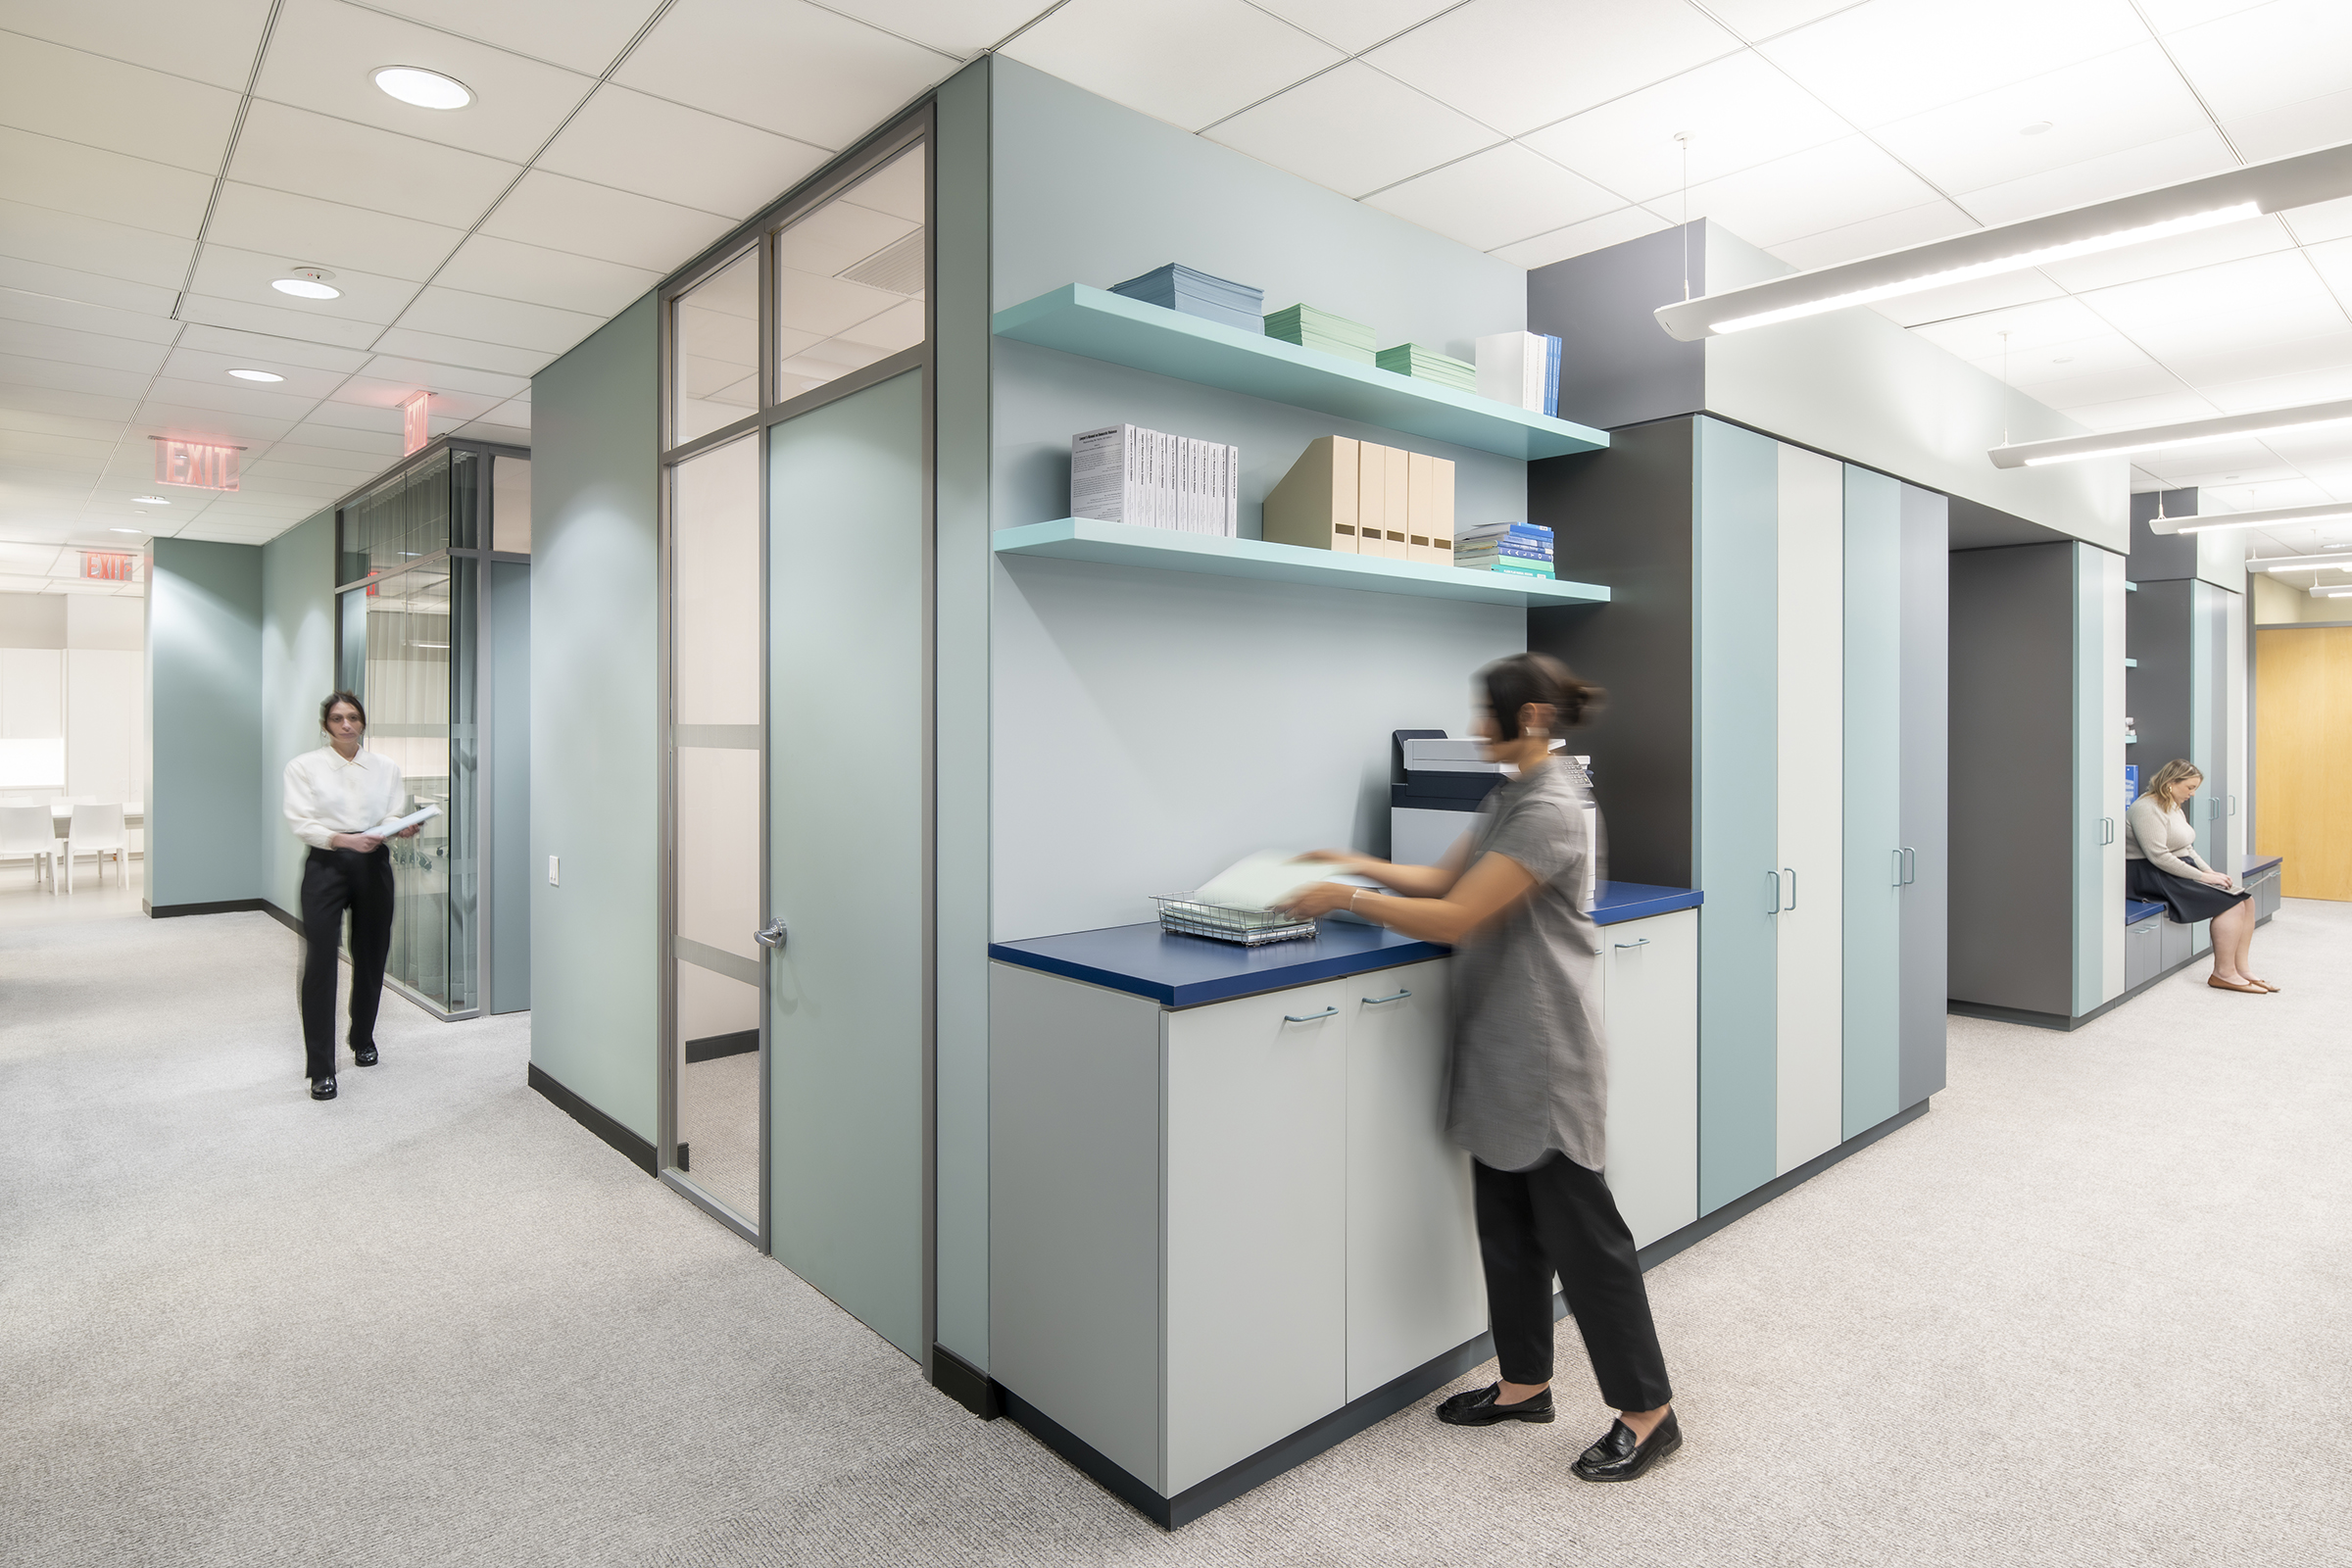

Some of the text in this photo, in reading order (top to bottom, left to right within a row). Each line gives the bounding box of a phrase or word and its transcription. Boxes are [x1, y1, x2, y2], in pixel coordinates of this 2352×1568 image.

[407, 396, 424, 450] EXIT
[166, 441, 231, 487] EXIT
[86, 553, 128, 580] EXIT
